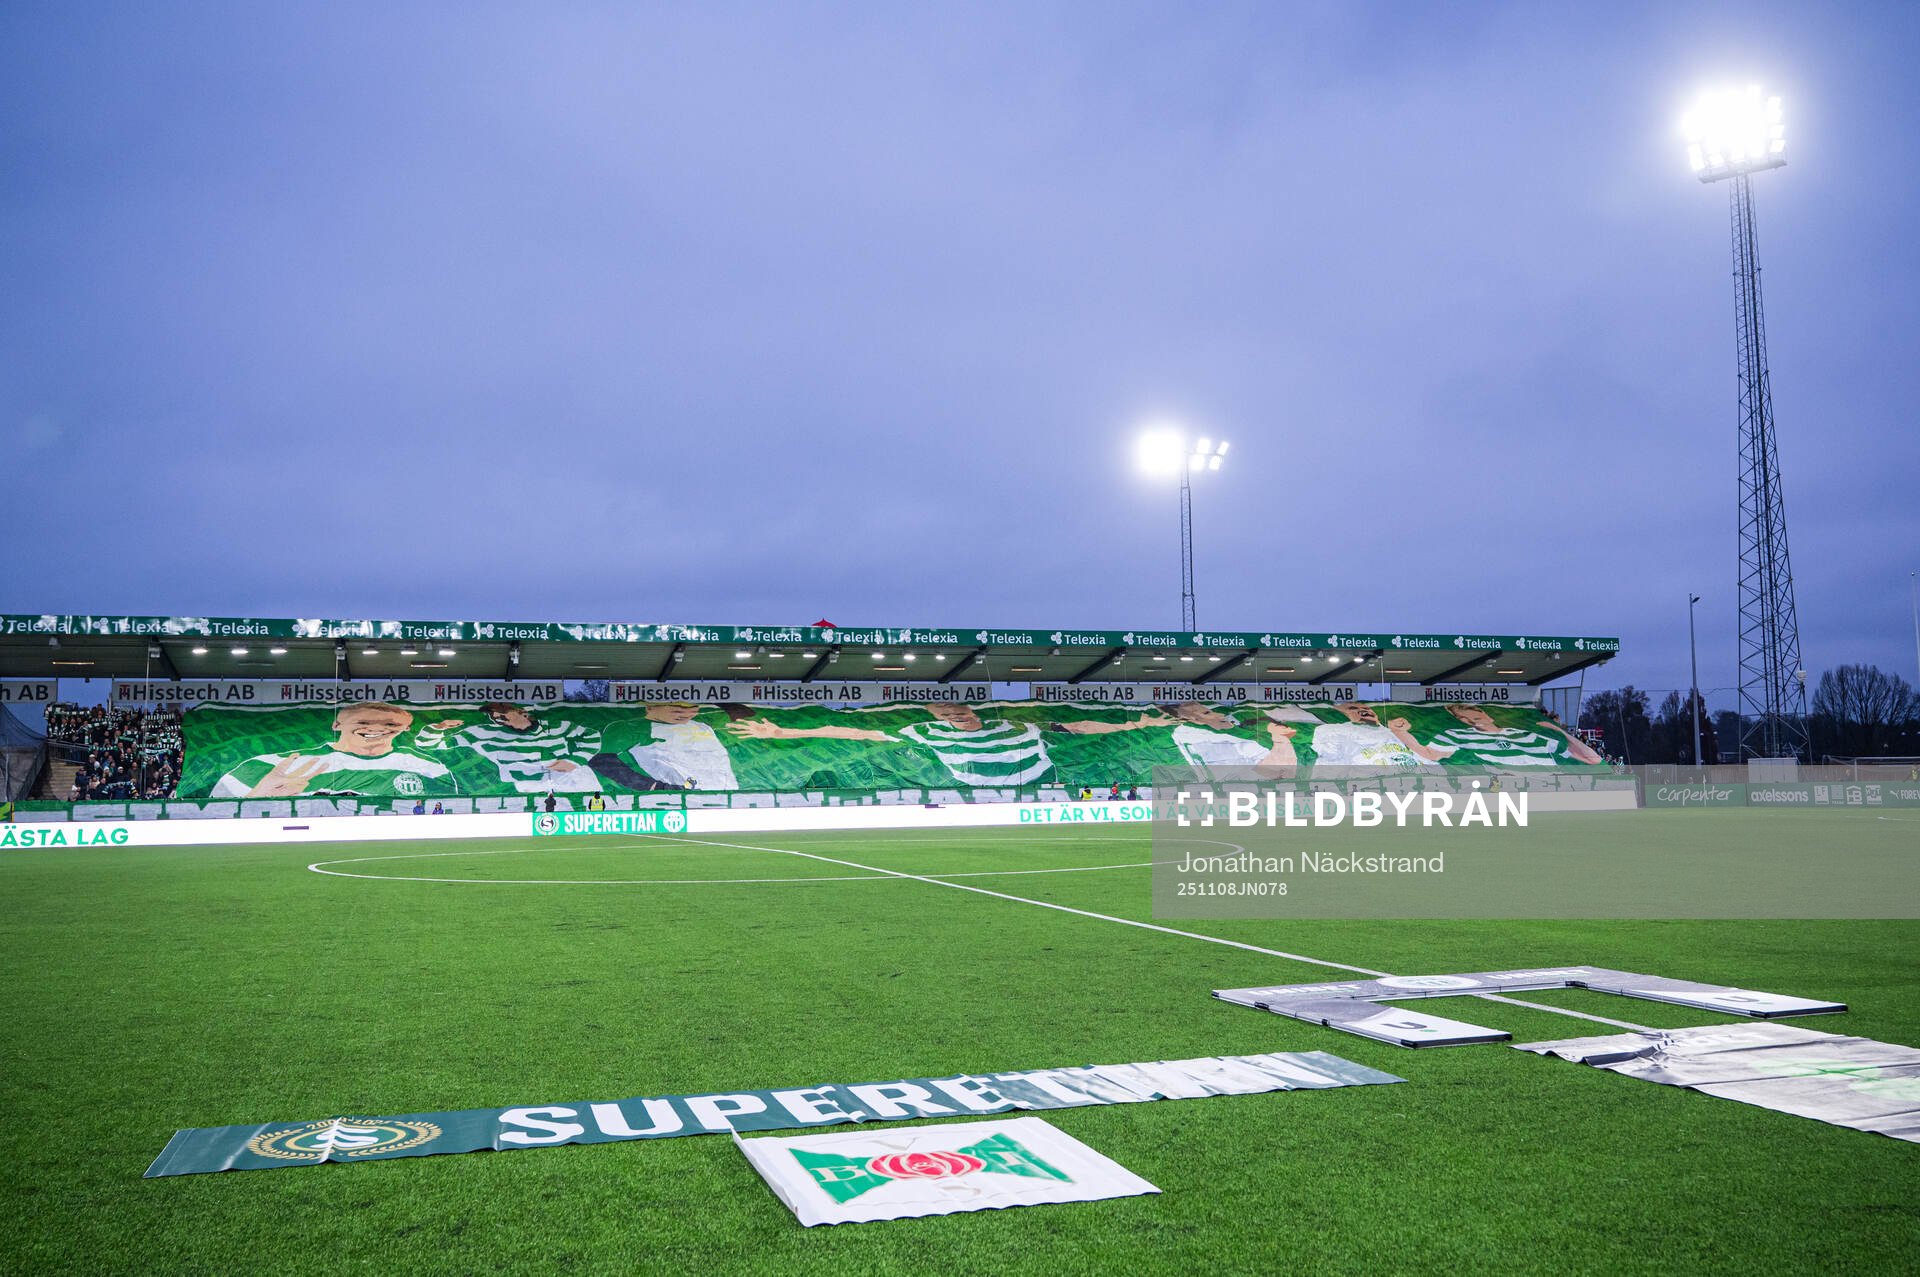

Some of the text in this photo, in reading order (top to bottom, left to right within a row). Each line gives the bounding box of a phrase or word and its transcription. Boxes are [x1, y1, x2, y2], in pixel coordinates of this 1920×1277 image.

[112, 620, 169, 632] Telexia
[212, 622, 269, 635] Telexia
[405, 625, 458, 637] Telexia
[497, 626, 549, 640] Telexia
[671, 629, 720, 641] Telexia
[755, 630, 803, 642] Telexia
[836, 631, 881, 643] Telexia
[914, 632, 959, 644] Telexia
[990, 633, 1033, 644] Telexia
[1064, 634, 1106, 645] Telexia
[1136, 635, 1177, 646] Telexia
[1205, 635, 1245, 647] Telexia
[1273, 636, 1312, 647] Telexia
[1340, 637, 1377, 648] Telexia
[1403, 637, 1440, 648] Telexia
[1465, 638, 1502, 649] Telexia
[1526, 639, 1562, 650] Telexia
[1585, 640, 1619, 651] Telexia
[18, 684, 49, 700] AB
[133, 684, 255, 700] Hisstech AB
[294, 684, 410, 700] Hisstech AB
[447, 684, 557, 700] Hisstech AB
[627, 685, 731, 700] Hisstech AB
[764, 685, 862, 700] Hisstech AB
[893, 685, 987, 701] Hisstech AB
[1046, 686, 1135, 701] Hisstech AB
[1162, 686, 1247, 701] Hisstech AB
[1273, 687, 1354, 701] Hisstech AB
[1434, 687, 1509, 701] Hisstech AB
[1657, 786, 1733, 806] Carpenter
[1751, 788, 1809, 802] axelssons
[1020, 808, 1054, 822] DET
[1060, 804, 1084, 821] ÄR
[1090, 807, 1115, 823] VI,
[1120, 806, 1160, 820] SOM
[1167, 802, 1189, 818] ÄR
[564, 813, 657, 832] SUPERETTAN
[0, 825, 129, 846] ÄSTA LAG
[499, 1052, 1341, 1145] SUPERETTAN
